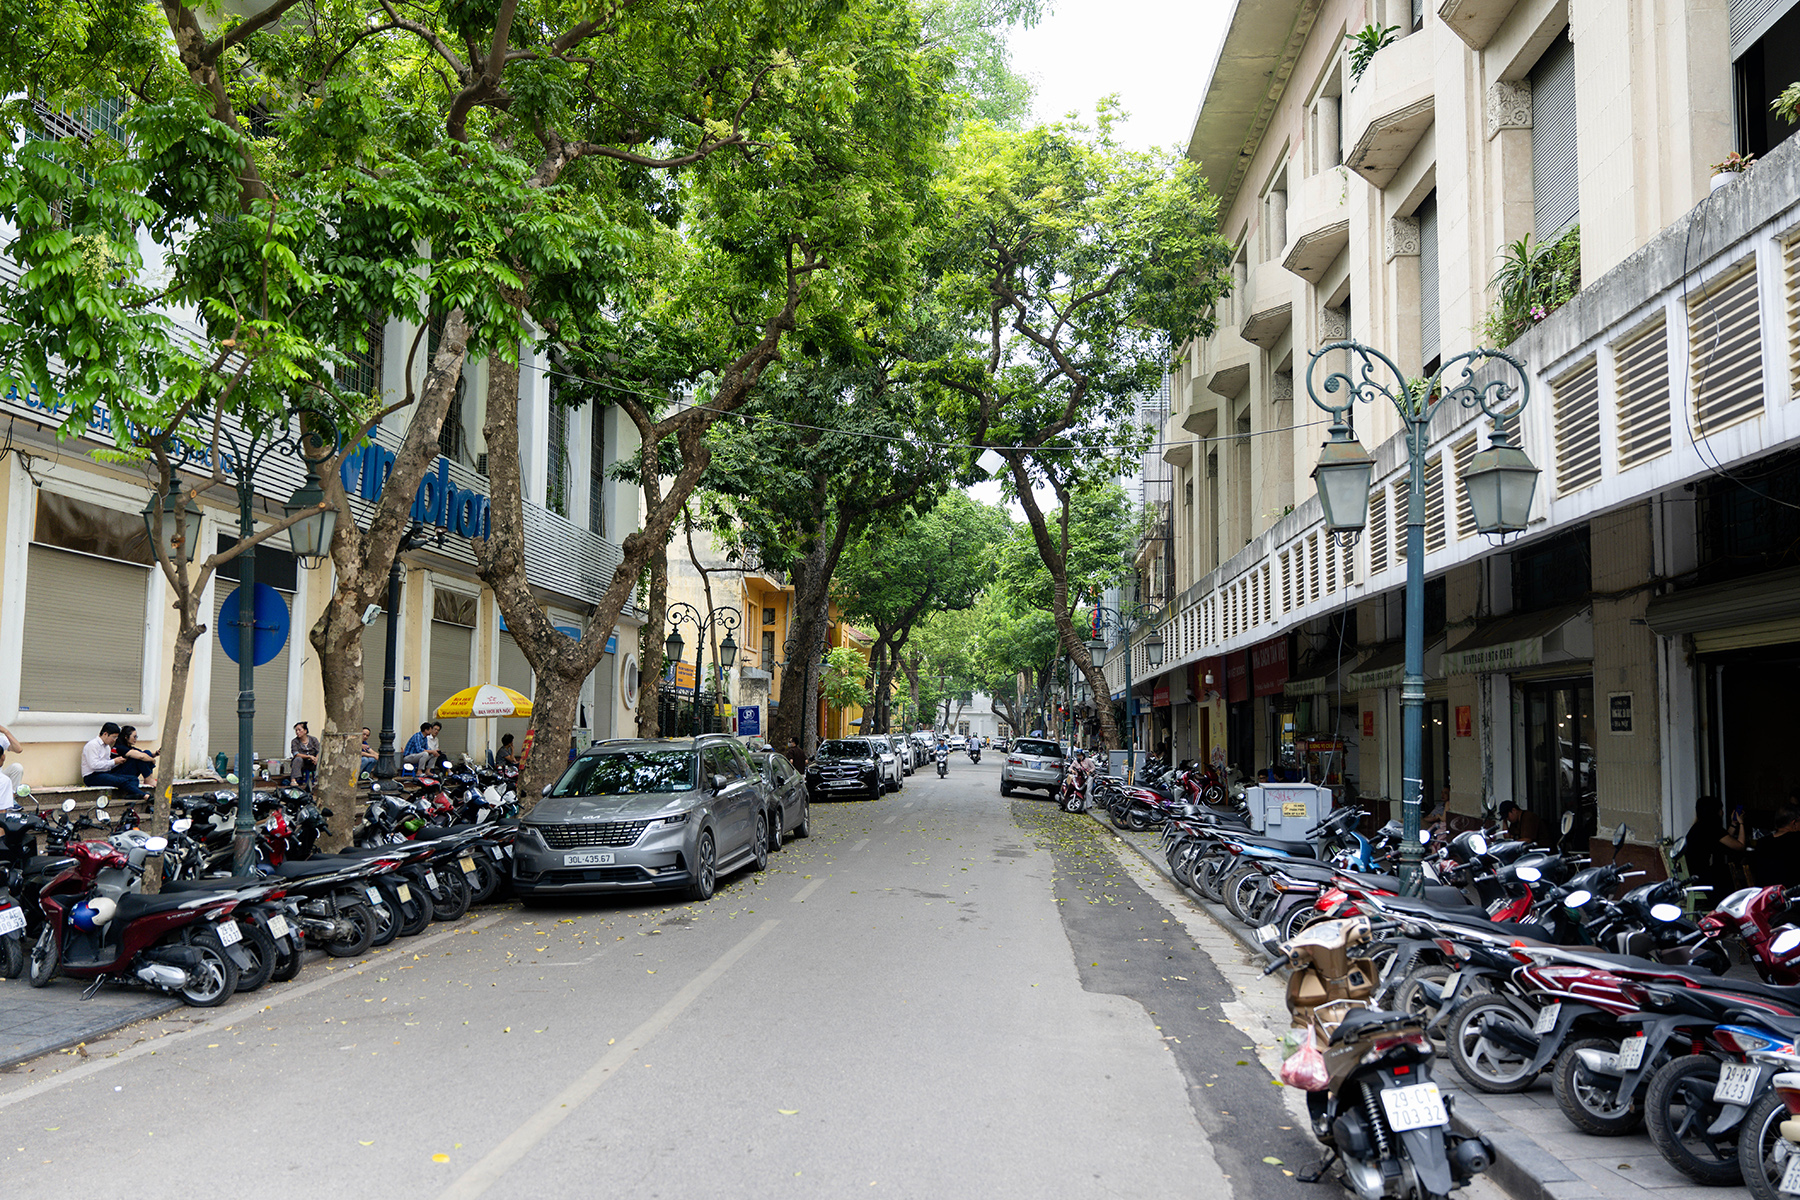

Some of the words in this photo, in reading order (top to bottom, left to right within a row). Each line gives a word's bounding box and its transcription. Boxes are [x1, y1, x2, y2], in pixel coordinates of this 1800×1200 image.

[1463, 653, 1484, 665] VINTAGE
[568, 855, 611, 864] 30L-435.67
[1391, 1088, 1431, 1108] 29-C1
